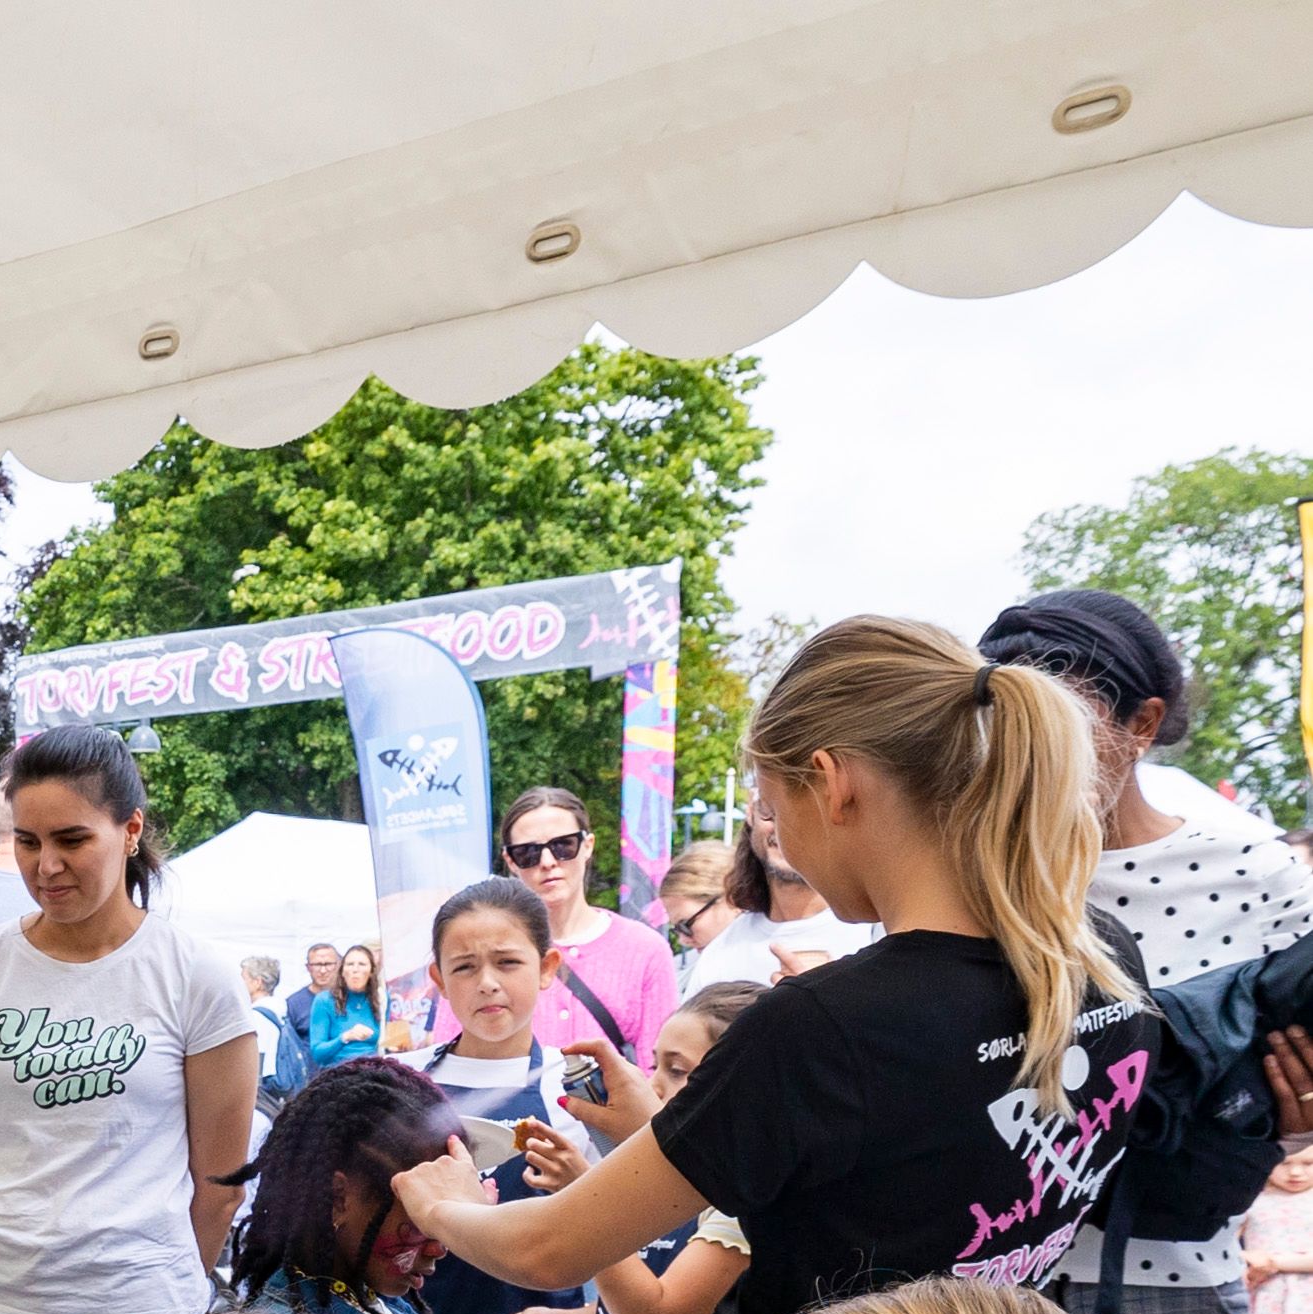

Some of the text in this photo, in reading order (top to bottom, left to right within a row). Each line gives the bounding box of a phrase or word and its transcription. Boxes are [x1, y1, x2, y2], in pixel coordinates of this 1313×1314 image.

[16, 648, 209, 725] TORVFEST
[209, 641, 250, 702] &
[258, 601, 566, 694] STROOD
[14, 1024, 146, 1083] totally
[34, 1068, 125, 1109] can.
